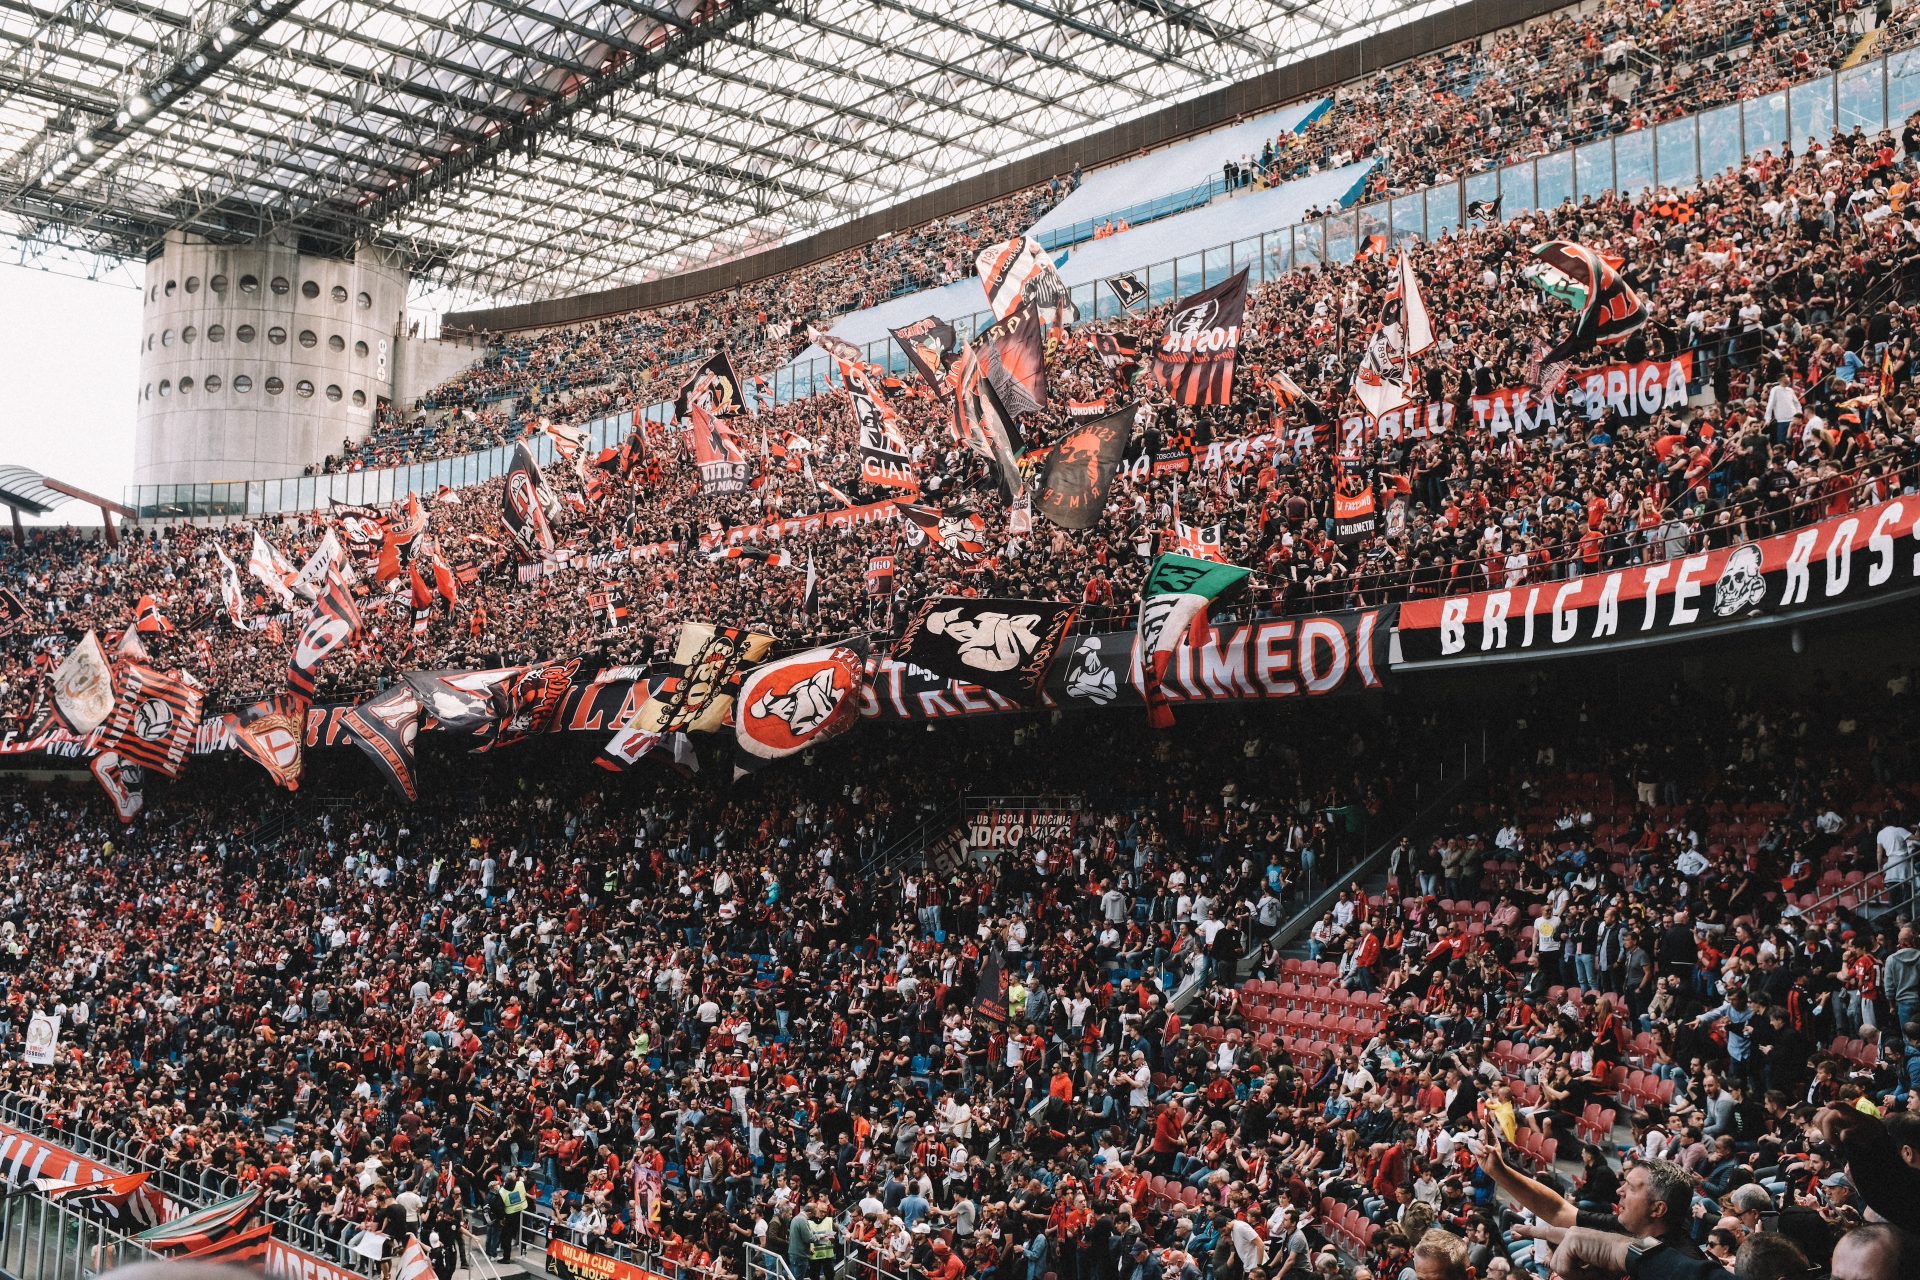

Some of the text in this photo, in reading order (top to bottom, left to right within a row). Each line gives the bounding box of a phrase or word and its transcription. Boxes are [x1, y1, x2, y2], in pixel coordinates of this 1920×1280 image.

[1472, 360, 1690, 438] TAKA BRIGA
[1440, 501, 1920, 656] BRIGATE ROS
[998, 813, 1025, 825] ISOLA
[925, 1153, 938, 1168] 19
[561, 1244, 617, 1274] MILAN CLUB
